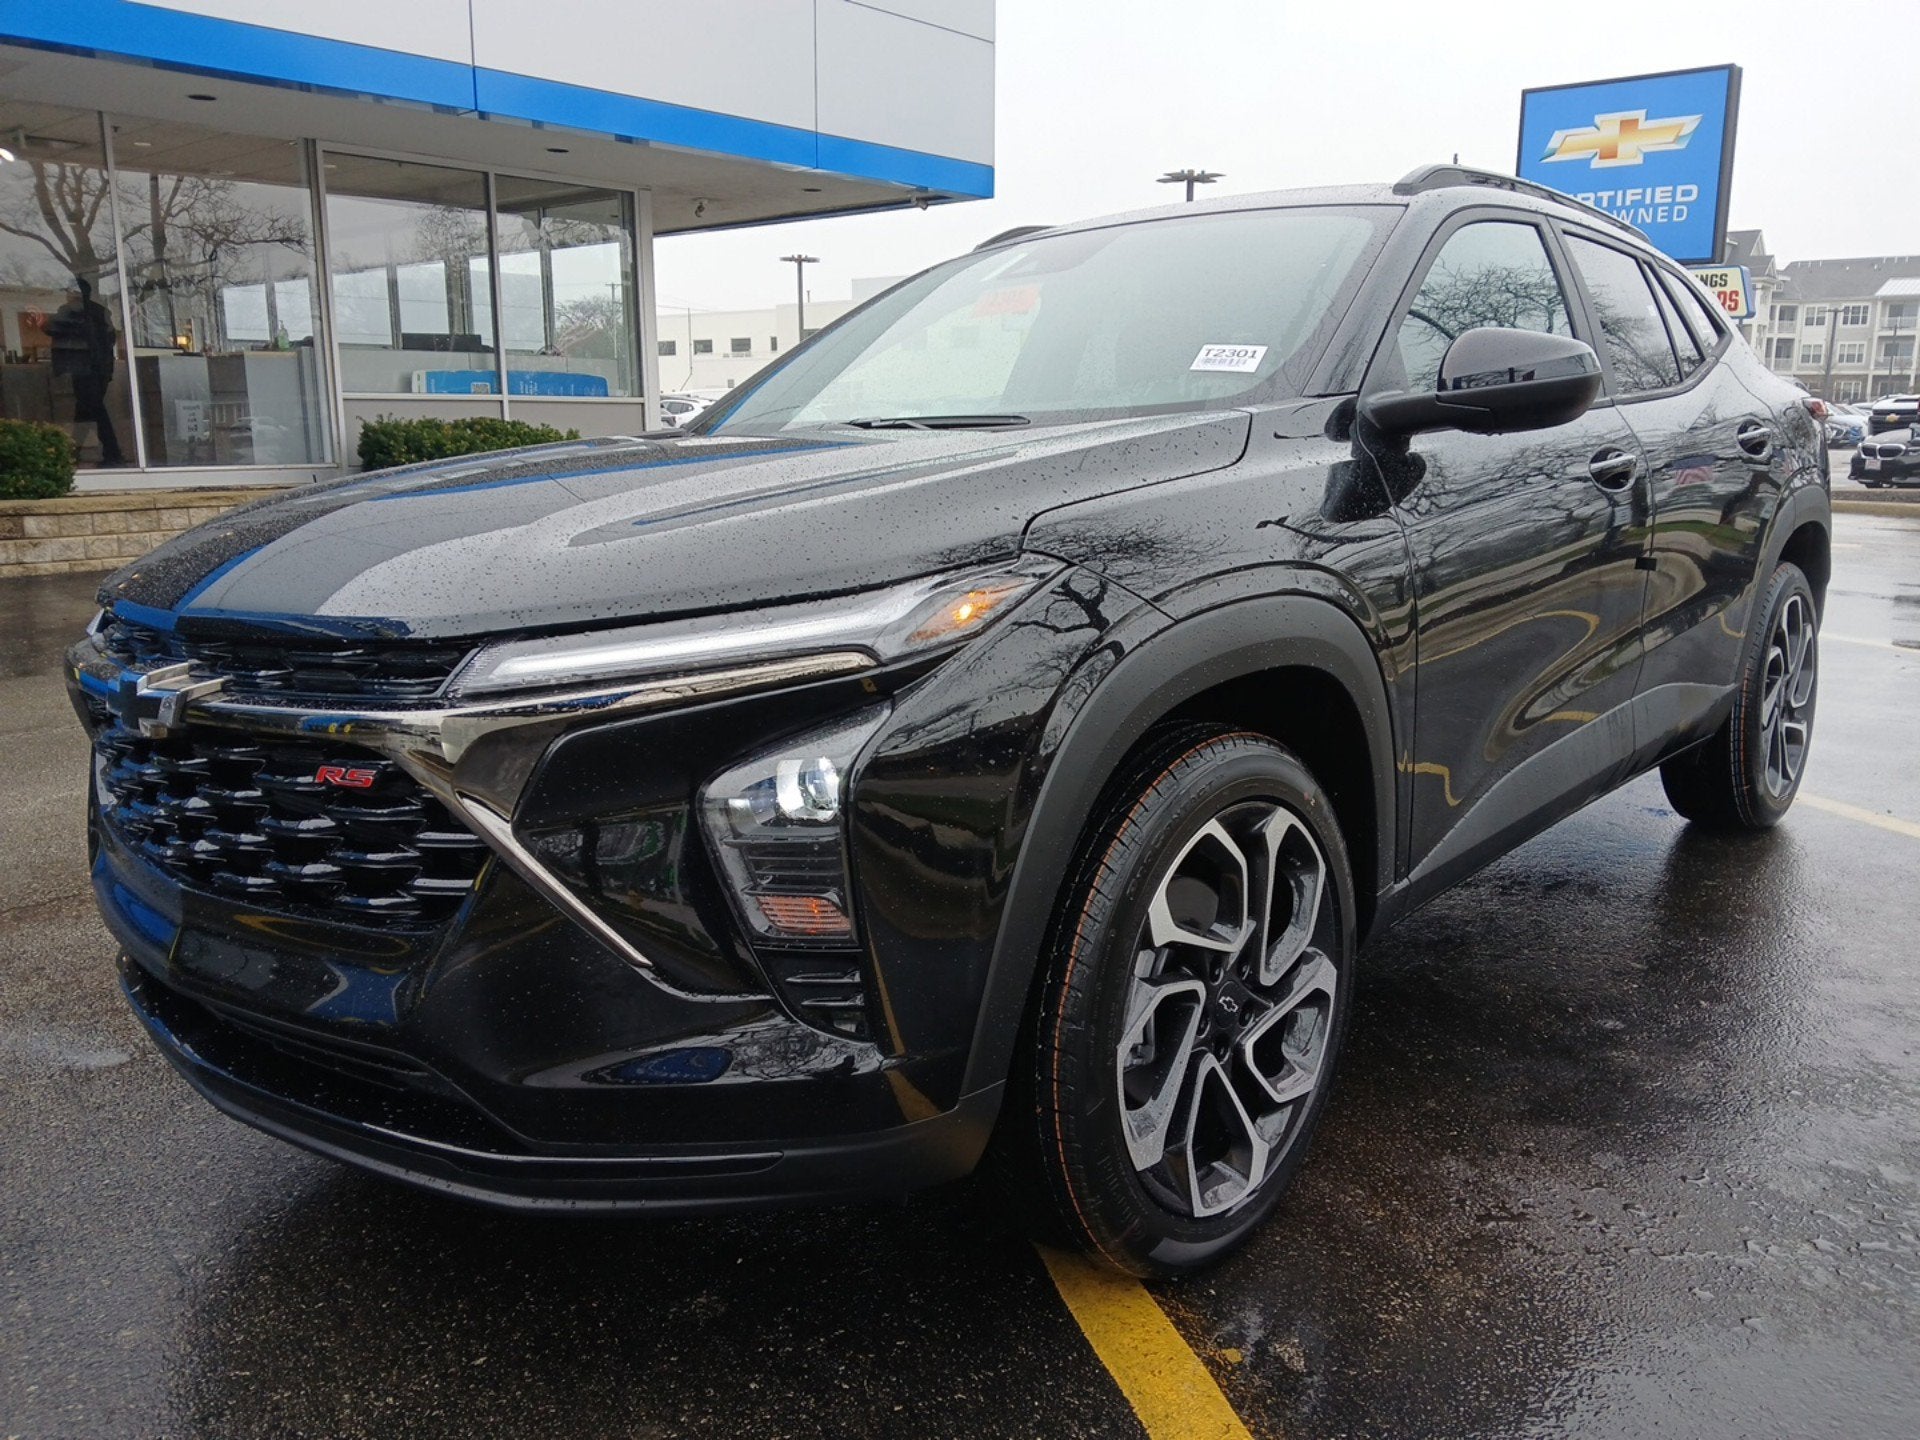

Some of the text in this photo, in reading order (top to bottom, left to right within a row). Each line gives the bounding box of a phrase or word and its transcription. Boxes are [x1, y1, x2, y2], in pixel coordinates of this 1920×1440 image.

[1568, 184, 1699, 208] RTIFIED
[1611, 205, 1688, 224] WNED
[1696, 273, 1728, 288] NGS
[1205, 348, 1257, 359] T2301
[315, 765, 377, 788] RS
